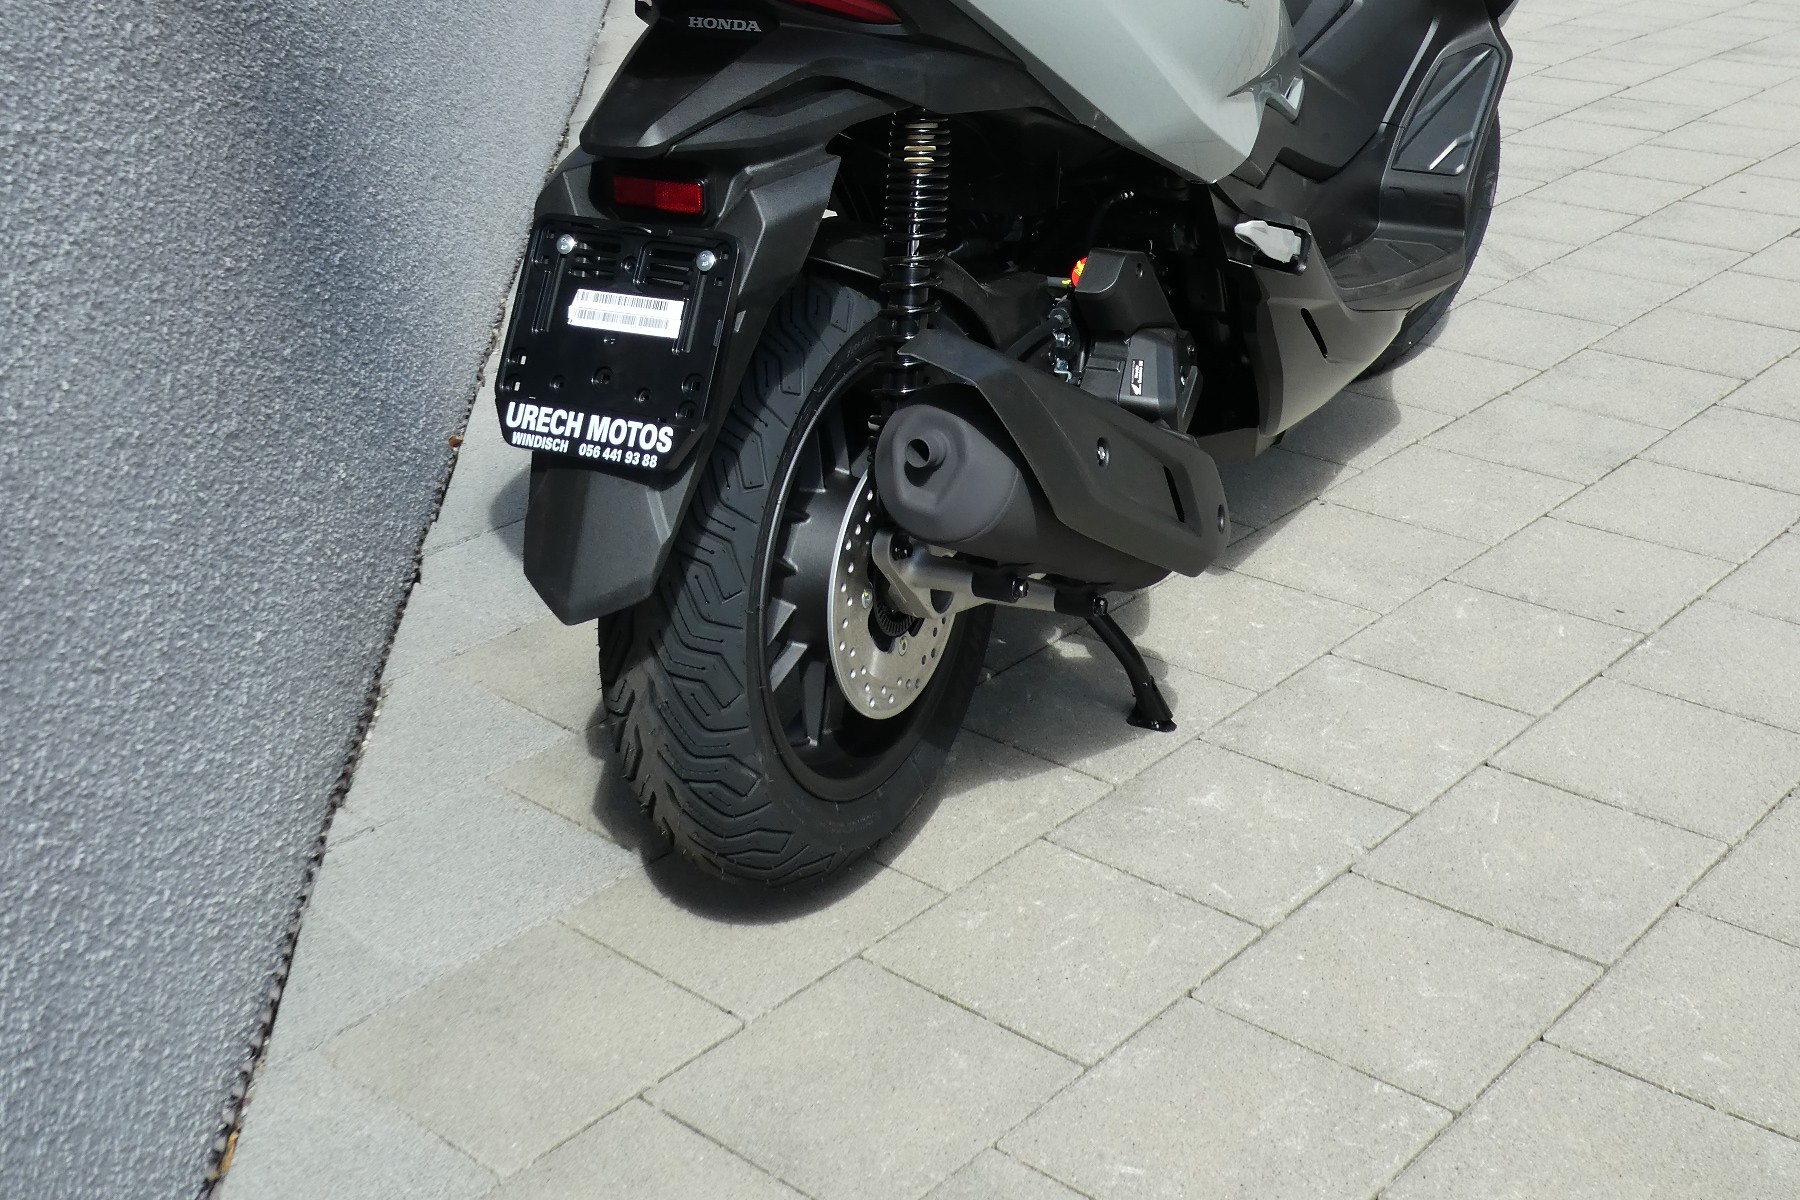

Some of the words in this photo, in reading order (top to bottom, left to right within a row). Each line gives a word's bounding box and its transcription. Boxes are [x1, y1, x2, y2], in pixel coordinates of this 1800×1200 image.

[687, 16, 762, 32] HONDA
[505, 401, 585, 440] URECH
[586, 414, 675, 454] MOTOS
[511, 431, 569, 454] WINDISCH
[578, 443, 601, 459] 056
[602, 447, 623, 463] 441
[624, 450, 640, 466] 93
[641, 454, 658, 469] 88
